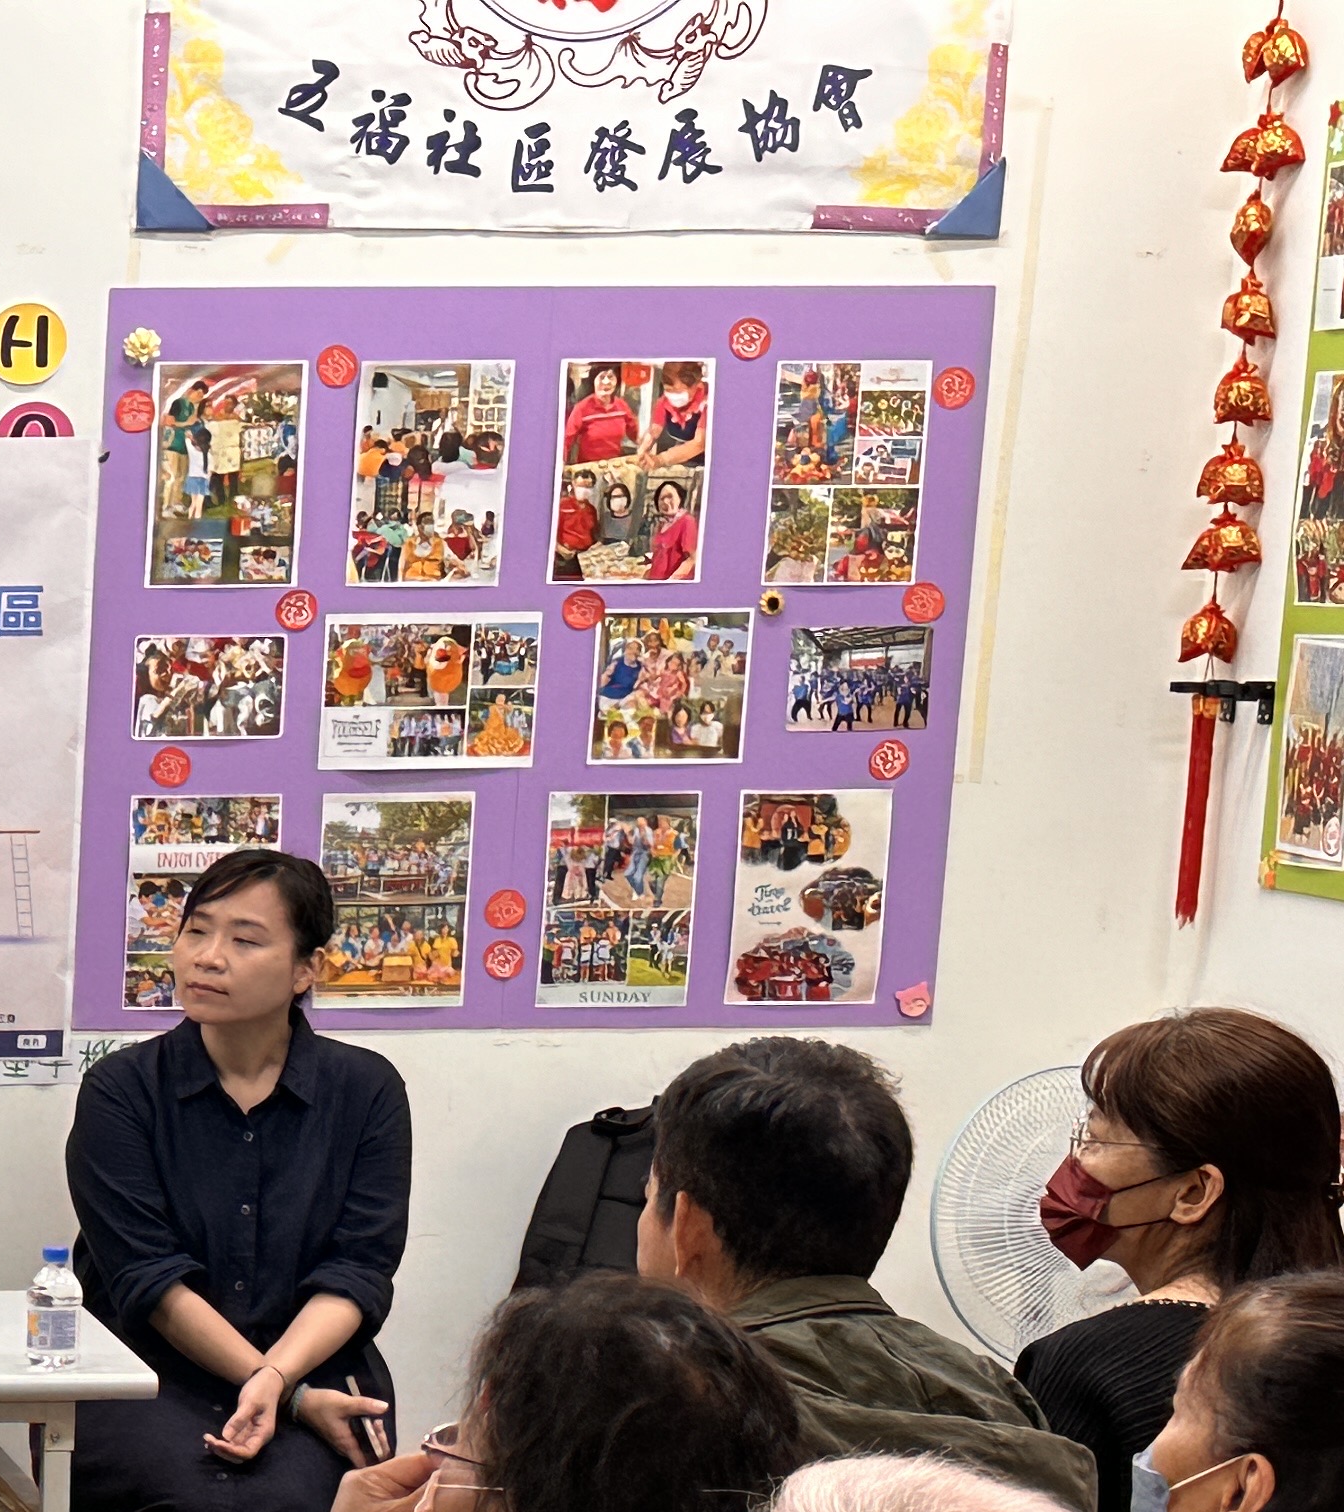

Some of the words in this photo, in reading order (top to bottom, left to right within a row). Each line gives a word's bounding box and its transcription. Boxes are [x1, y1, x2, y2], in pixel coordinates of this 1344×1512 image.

[278, 58, 873, 194] 五福社區發展協會
[578, 991, 652, 1003] SUNDAY
